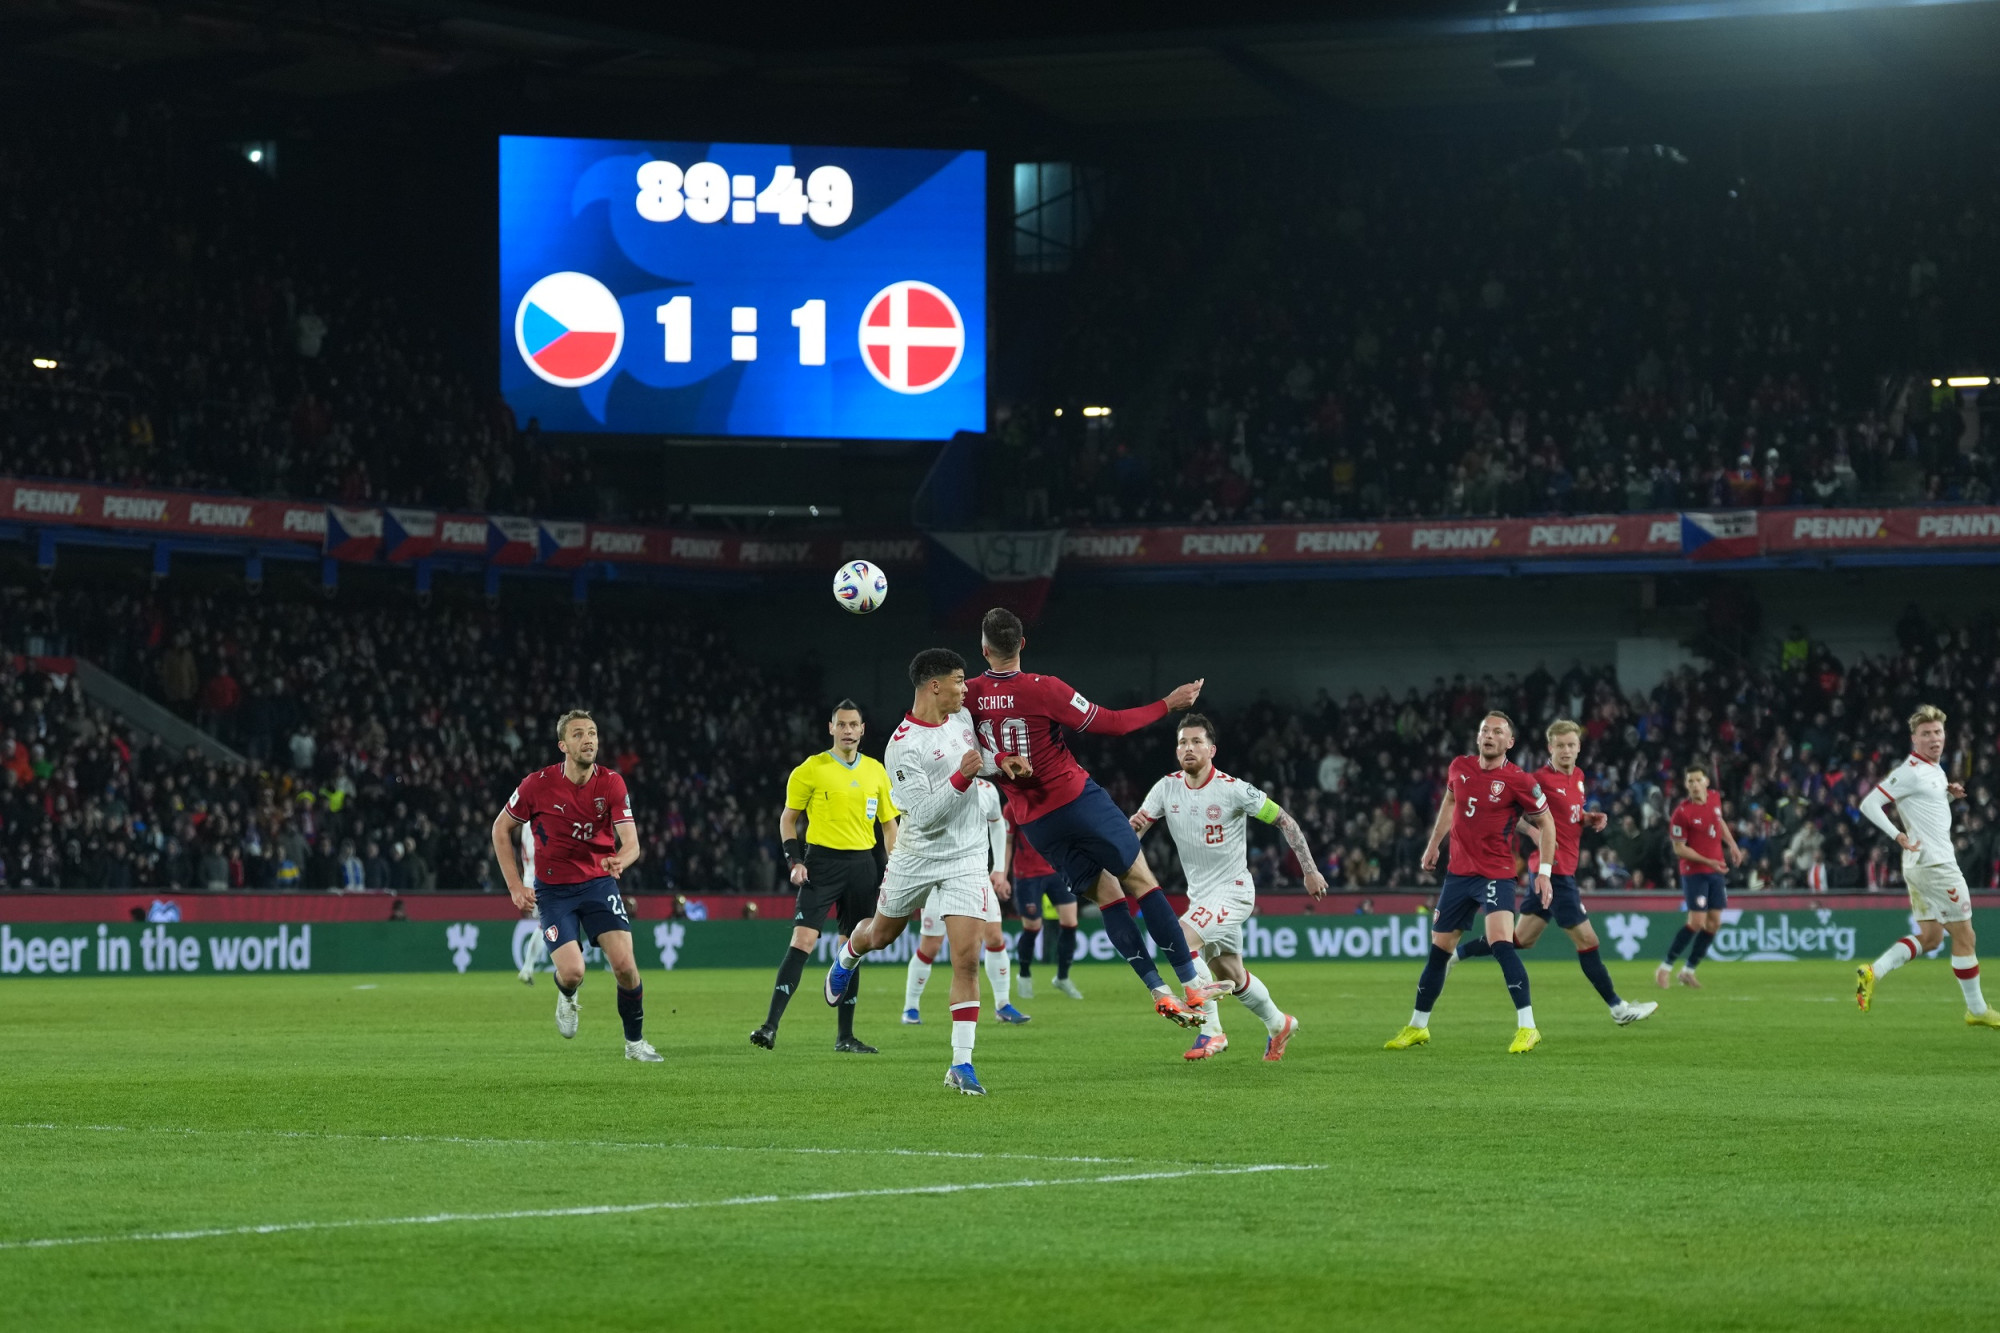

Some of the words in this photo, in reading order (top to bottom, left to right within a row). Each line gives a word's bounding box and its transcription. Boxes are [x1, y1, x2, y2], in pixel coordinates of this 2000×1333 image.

[635, 161, 853, 227] 89:49
[656, 296, 692, 363] 1
[791, 299, 826, 366] 1
[977, 694, 1015, 710] SCHICK
[977, 717, 1033, 767] 10
[1465, 796, 1478, 817] 5
[571, 822, 593, 840] 22
[1205, 824, 1224, 844] 23
[1708, 824, 1716, 838] 4
[1487, 880, 1497, 898] 5
[1190, 906, 1213, 928] 23
[1307, 915, 1428, 957] world
[0, 924, 88, 973] beer
[97, 923, 131, 972] in
[140, 923, 200, 972] the
[208, 923, 311, 970] world
